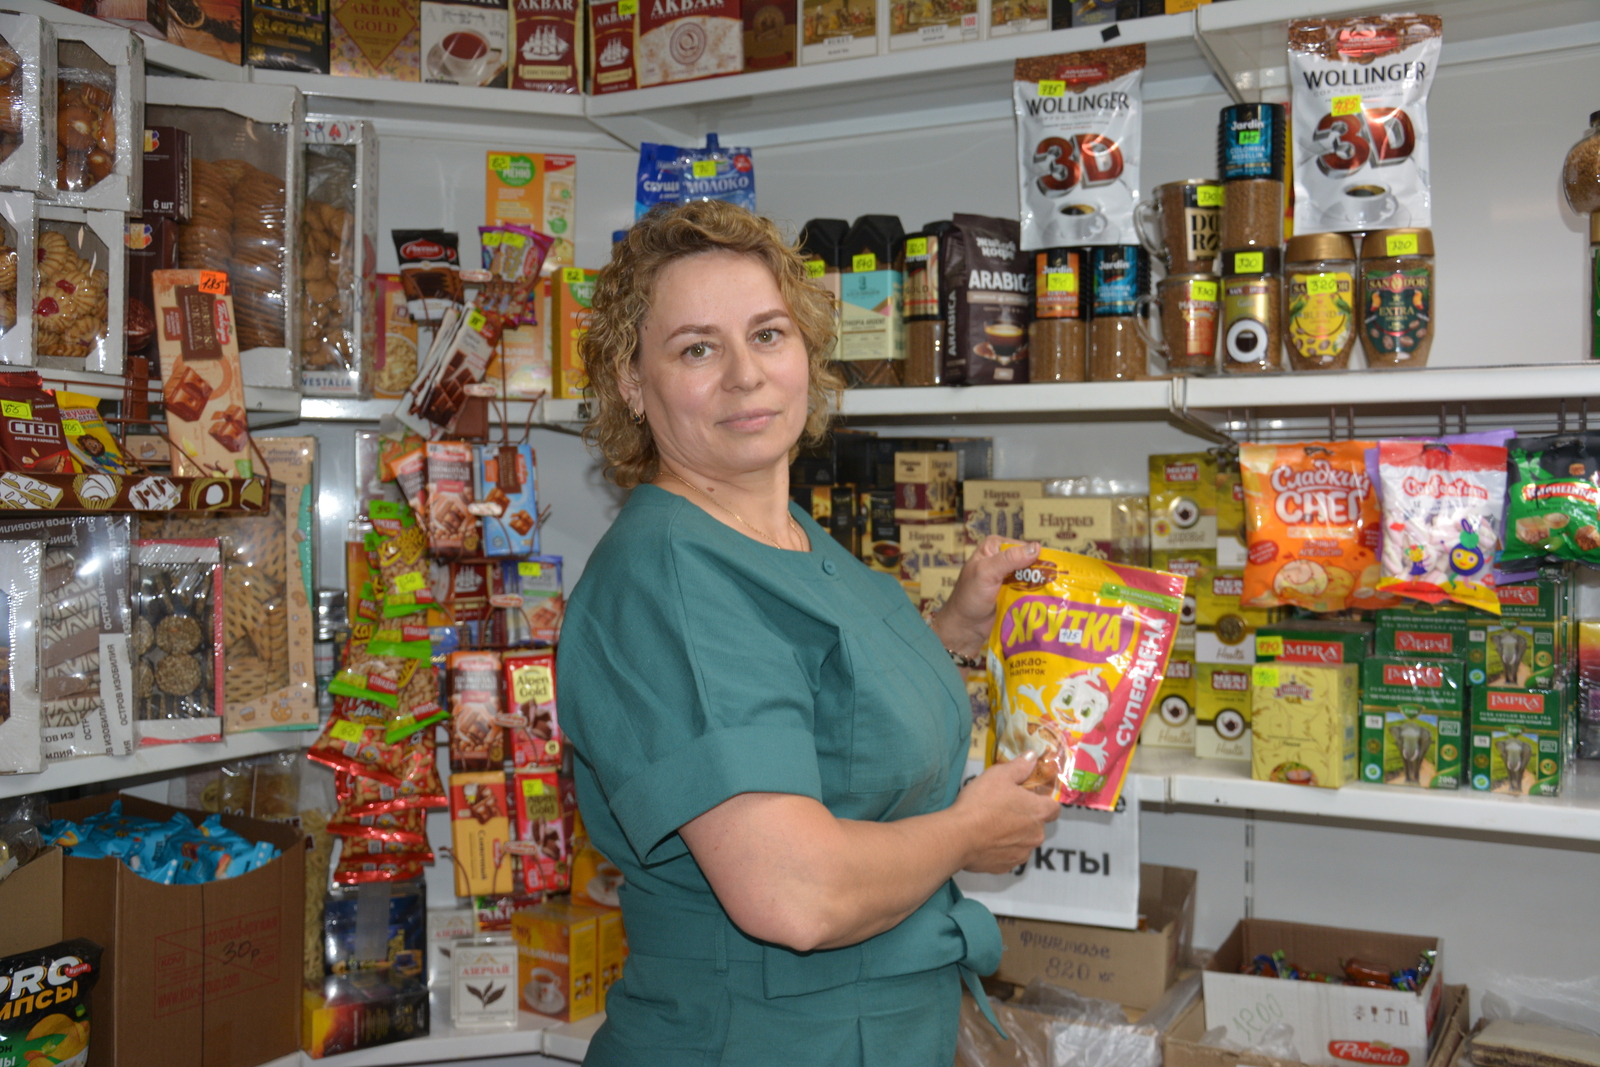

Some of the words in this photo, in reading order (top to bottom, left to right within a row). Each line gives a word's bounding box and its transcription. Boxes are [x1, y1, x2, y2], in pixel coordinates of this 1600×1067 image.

[353, 19, 398, 35] GOLD
[1303, 61, 1426, 90] WOLLINGER
[1025, 91, 1130, 117] WOLLINGER
[1230, 118, 1265, 131] Jardin
[1312, 107, 1416, 179] 3D
[1033, 133, 1124, 198] 3D
[685, 177, 749, 194] МОЛОКО
[1098, 260, 1130, 271] Jardin
[202, 278, 225, 290] 185
[1369, 280, 1390, 289] SAN
[1378, 305, 1415, 317] EXTRA
[302, 377, 352, 387] VESTALIA
[9, 421, 58, 438] СТЕП
[1271, 460, 1370, 493] Сладкий
[1275, 488, 1367, 524] СНЕГ
[1039, 513, 1094, 532] Наурыз
[1213, 579, 1243, 588] MER
[1213, 586, 1243, 595] CHA
[1496, 588, 1536, 604] MPRA
[100, 594, 112, 630] ОСТРОВ
[1006, 600, 1122, 653] ХРУТКА
[1281, 643, 1339, 663] IMPRA
[107, 643, 122, 692] ИЗОБИЛИЯ
[516, 674, 550, 689] Alpen
[1115, 616, 1168, 748] СУПЕРЦЕНА
[1212, 673, 1248, 683] MERI
[519, 686, 548, 698] Gold
[115, 691, 128, 726] ОСТРОВ
[1490, 694, 1540, 712] IMPRA
[529, 802, 558, 816] Gold
[434, 928, 472, 939] АЗЕРЧА
[461, 963, 511, 976] АЗЕРЧАЙ
[1335, 1040, 1405, 1066] Pobeda
